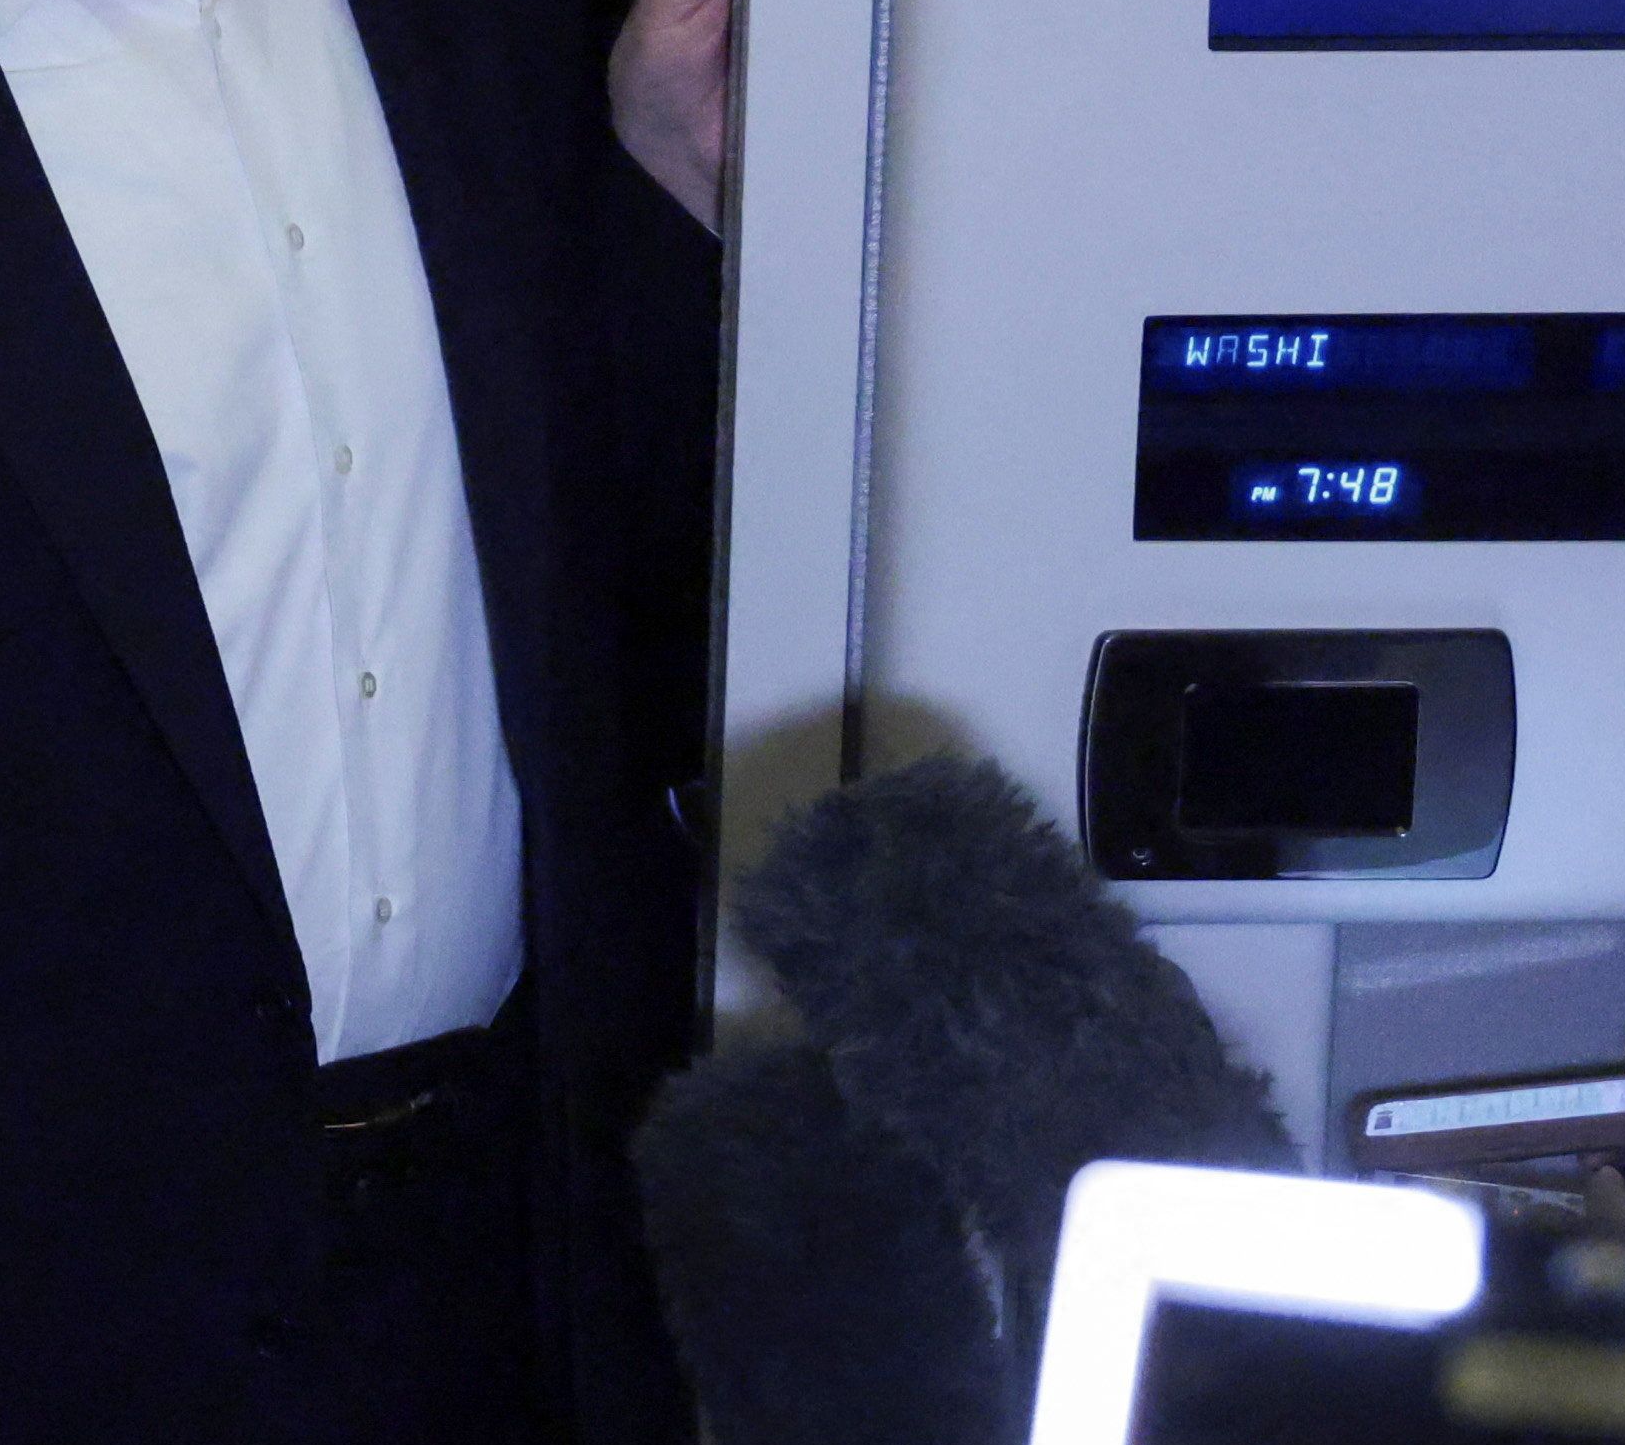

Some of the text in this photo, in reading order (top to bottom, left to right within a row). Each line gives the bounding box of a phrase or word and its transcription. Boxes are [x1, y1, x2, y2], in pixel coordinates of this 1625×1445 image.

[1184, 332, 1329, 369] WASHI
[1250, 466, 1399, 504] PM 7:48
